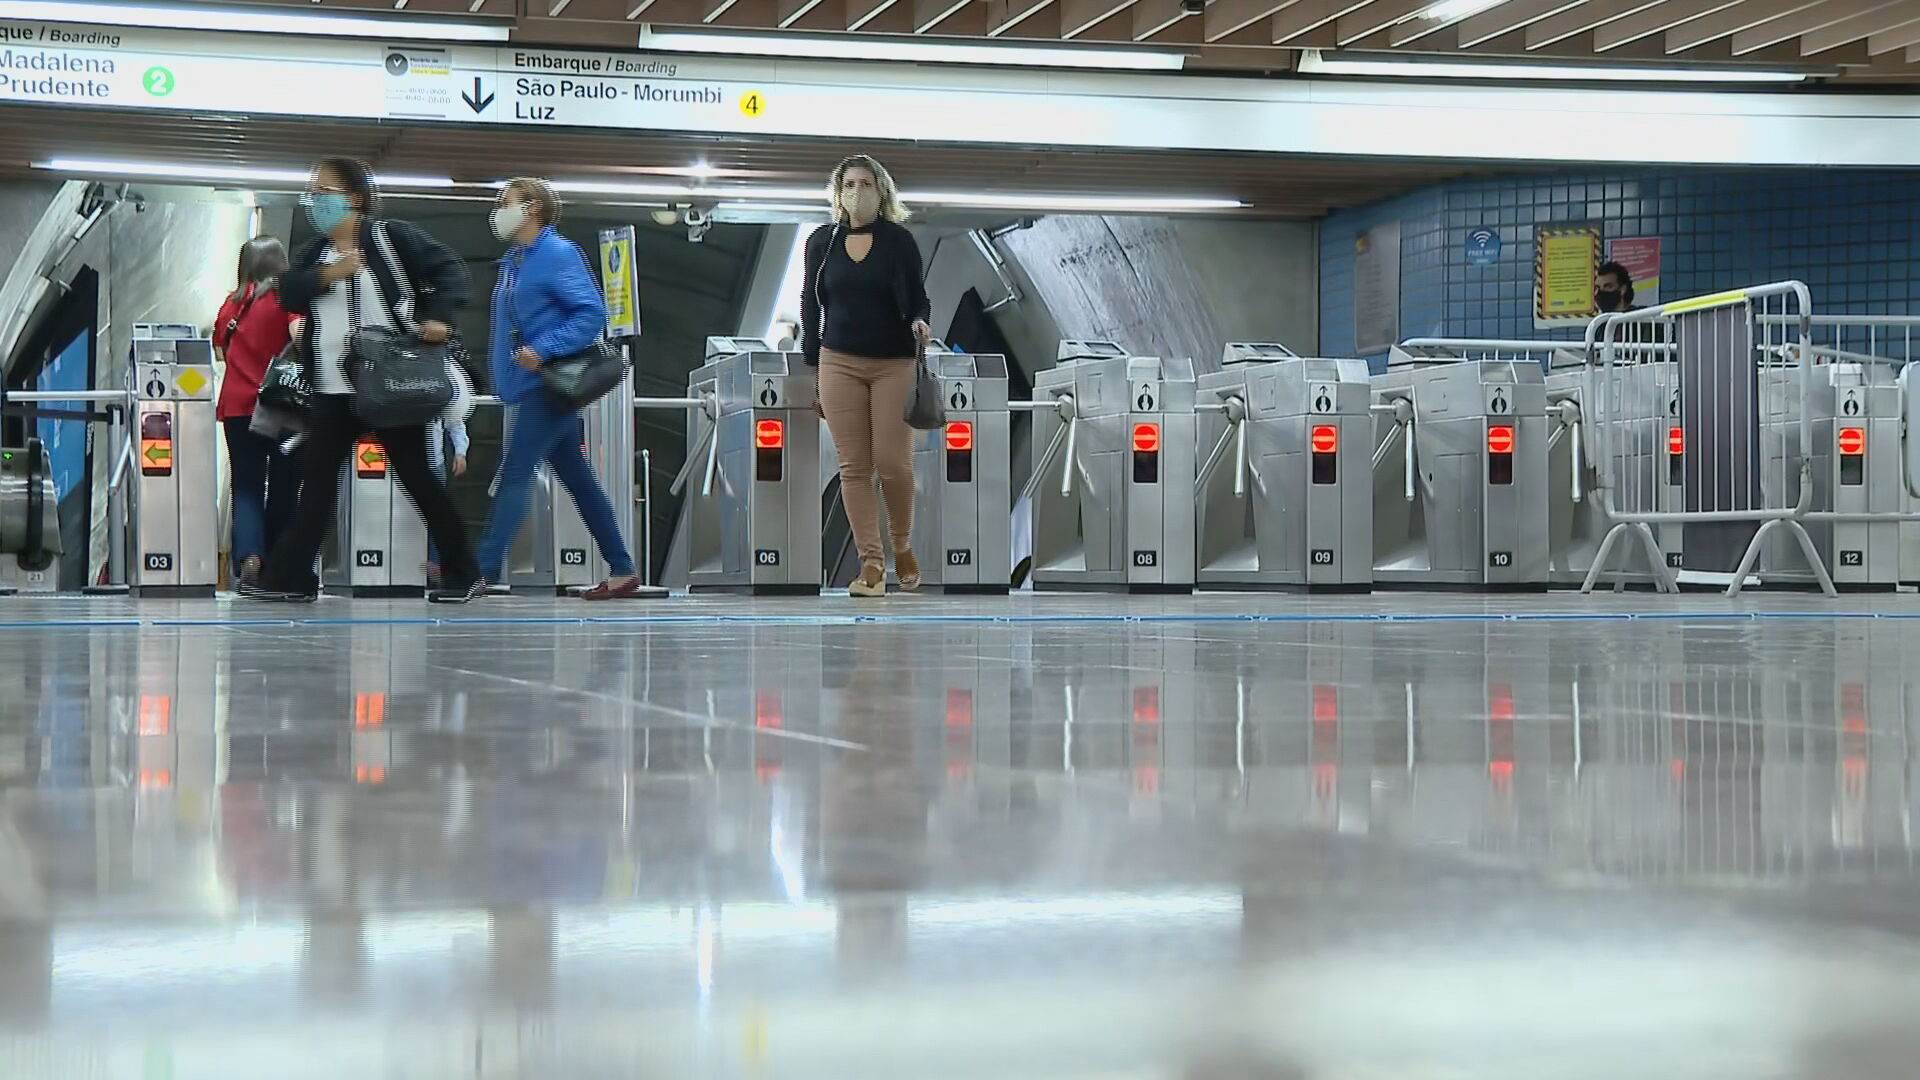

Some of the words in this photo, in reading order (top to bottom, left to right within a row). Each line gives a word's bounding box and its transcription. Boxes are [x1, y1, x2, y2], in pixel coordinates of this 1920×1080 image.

[50, 29, 121, 48] Boarding
[0, 50, 115, 74] Madalena
[515, 52, 601, 73] Embarque
[605, 57, 612, 71] /
[615, 60, 677, 77] Boarding
[0, 74, 110, 97] Prudente
[150, 70, 168, 97] 2
[516, 78, 556, 97] São
[560, 80, 618, 100] Paulo
[634, 83, 722, 104] Morumbi
[515, 101, 556, 120] Luz
[745, 95, 759, 114] 4
[149, 556, 168, 568] 03
[360, 553, 379, 565] 04
[565, 552, 582, 563] 05
[759, 552, 776, 564] 06
[951, 552, 967, 564] 07
[1137, 554, 1153, 565] 08
[1315, 552, 1331, 563] 09
[1494, 554, 1508, 565] 10
[1844, 553, 1859, 564] 12
